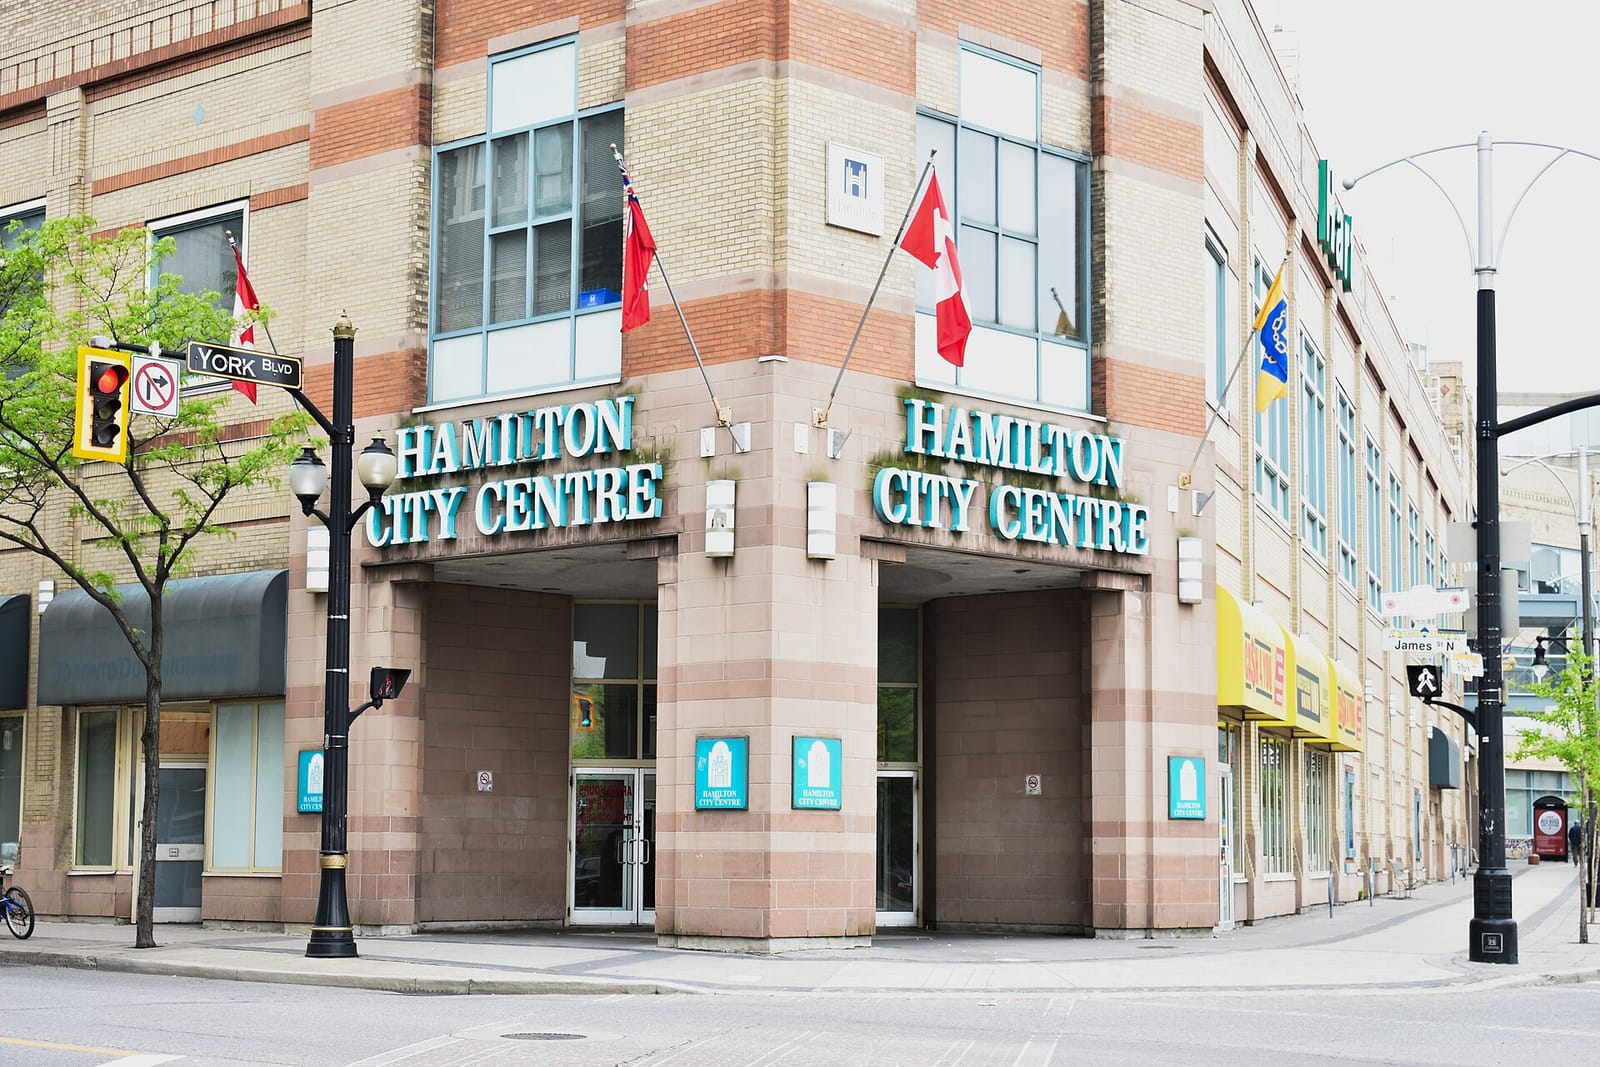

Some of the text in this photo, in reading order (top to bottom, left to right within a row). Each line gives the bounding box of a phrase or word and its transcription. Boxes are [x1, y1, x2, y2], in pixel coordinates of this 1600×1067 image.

[197, 347, 293, 377] YORK BLVD
[394, 396, 635, 479] HAMILTON
[904, 398, 1126, 489] HAMILTON
[365, 462, 663, 548] CITY CENTRE
[873, 466, 1150, 556] CITY CENTRE
[1394, 640, 1432, 651] James
[1446, 641, 1454, 651] N
[699, 798, 741, 806] CITY CENTRE
[703, 790, 737, 798] HAMILTON
[798, 798, 813, 806] CITY
[803, 789, 834, 798] HAMILTON
